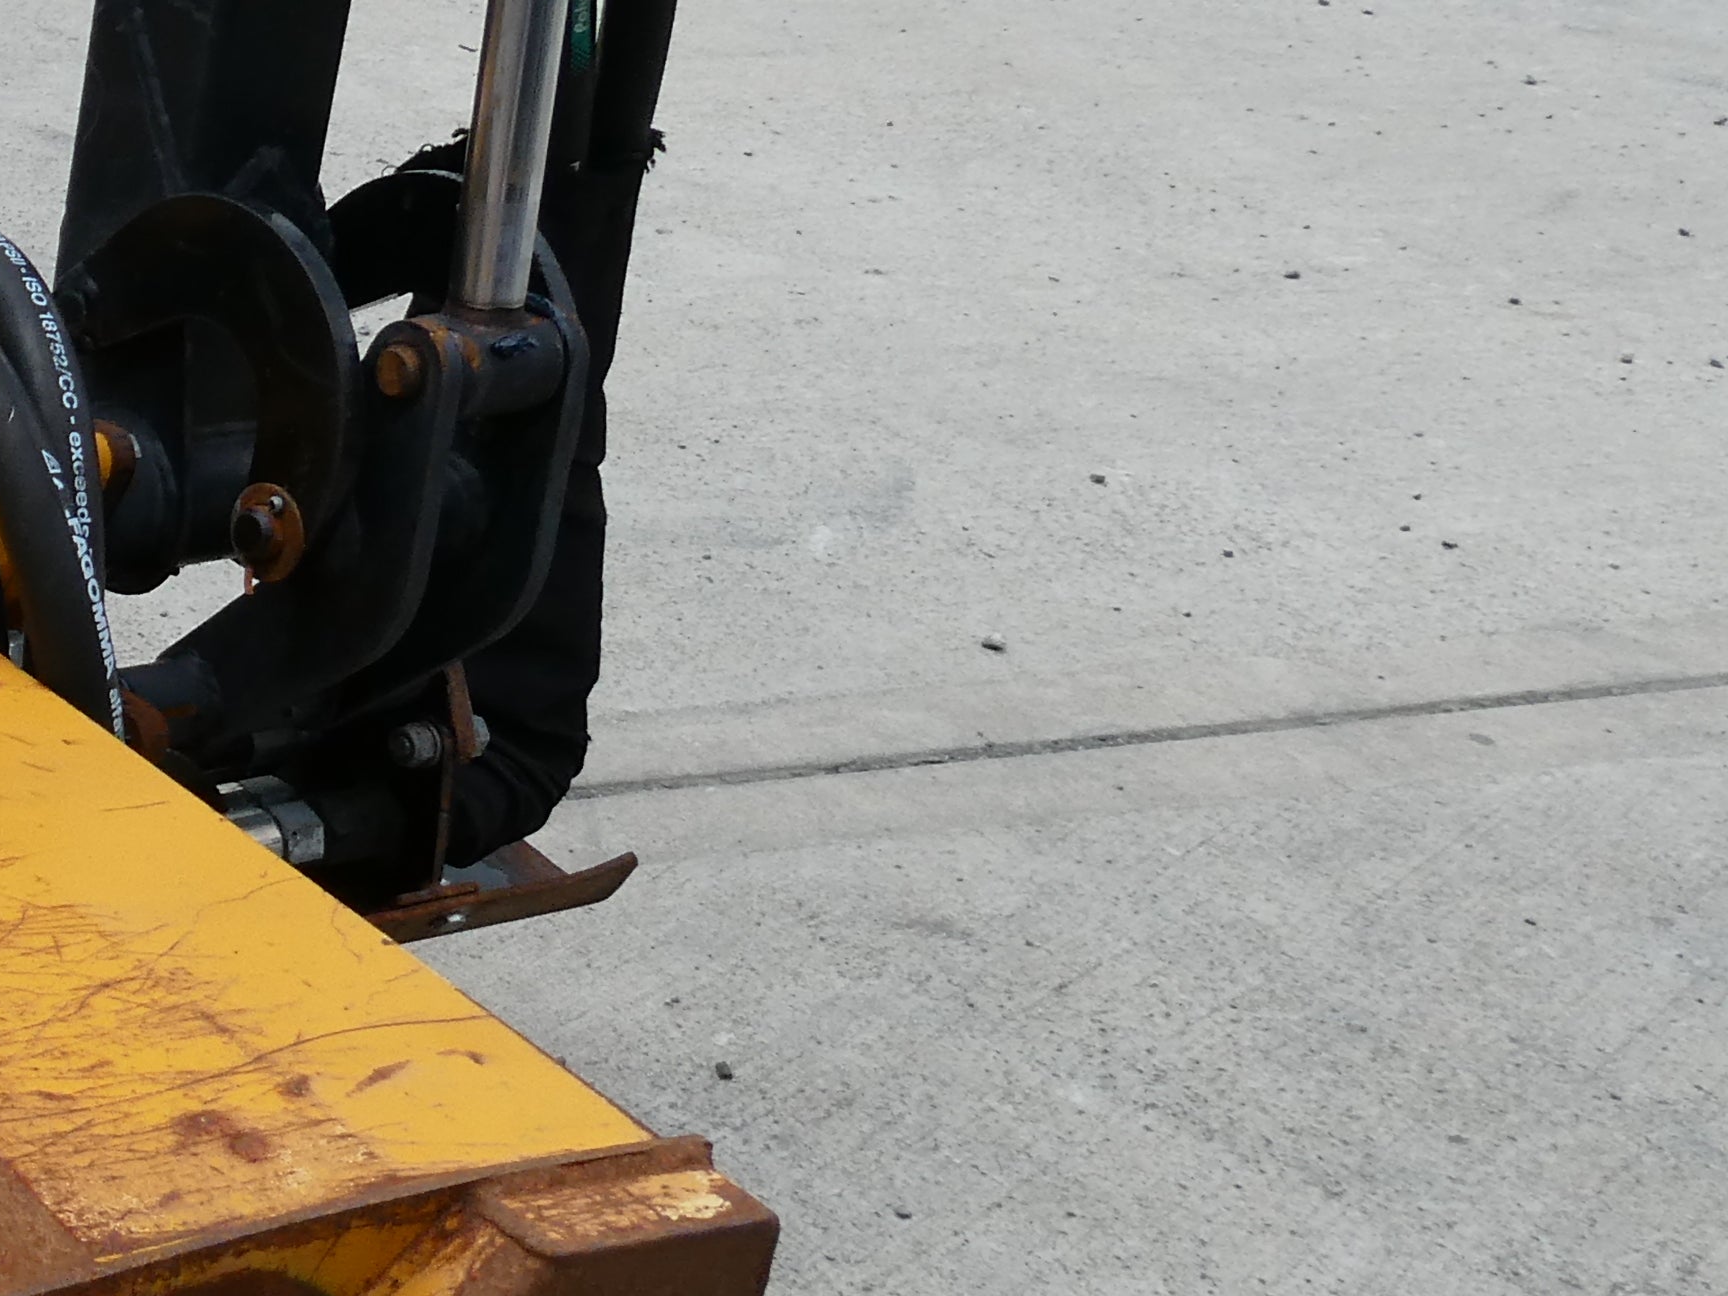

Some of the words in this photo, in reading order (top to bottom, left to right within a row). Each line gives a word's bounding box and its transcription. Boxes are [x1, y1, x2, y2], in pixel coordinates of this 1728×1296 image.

[21, 276, 48, 307] ISO
[39, 311, 79, 410] 18752/CC
[68, 431, 92, 539] exceeds
[52, 476, 116, 681] FAGOMMA
